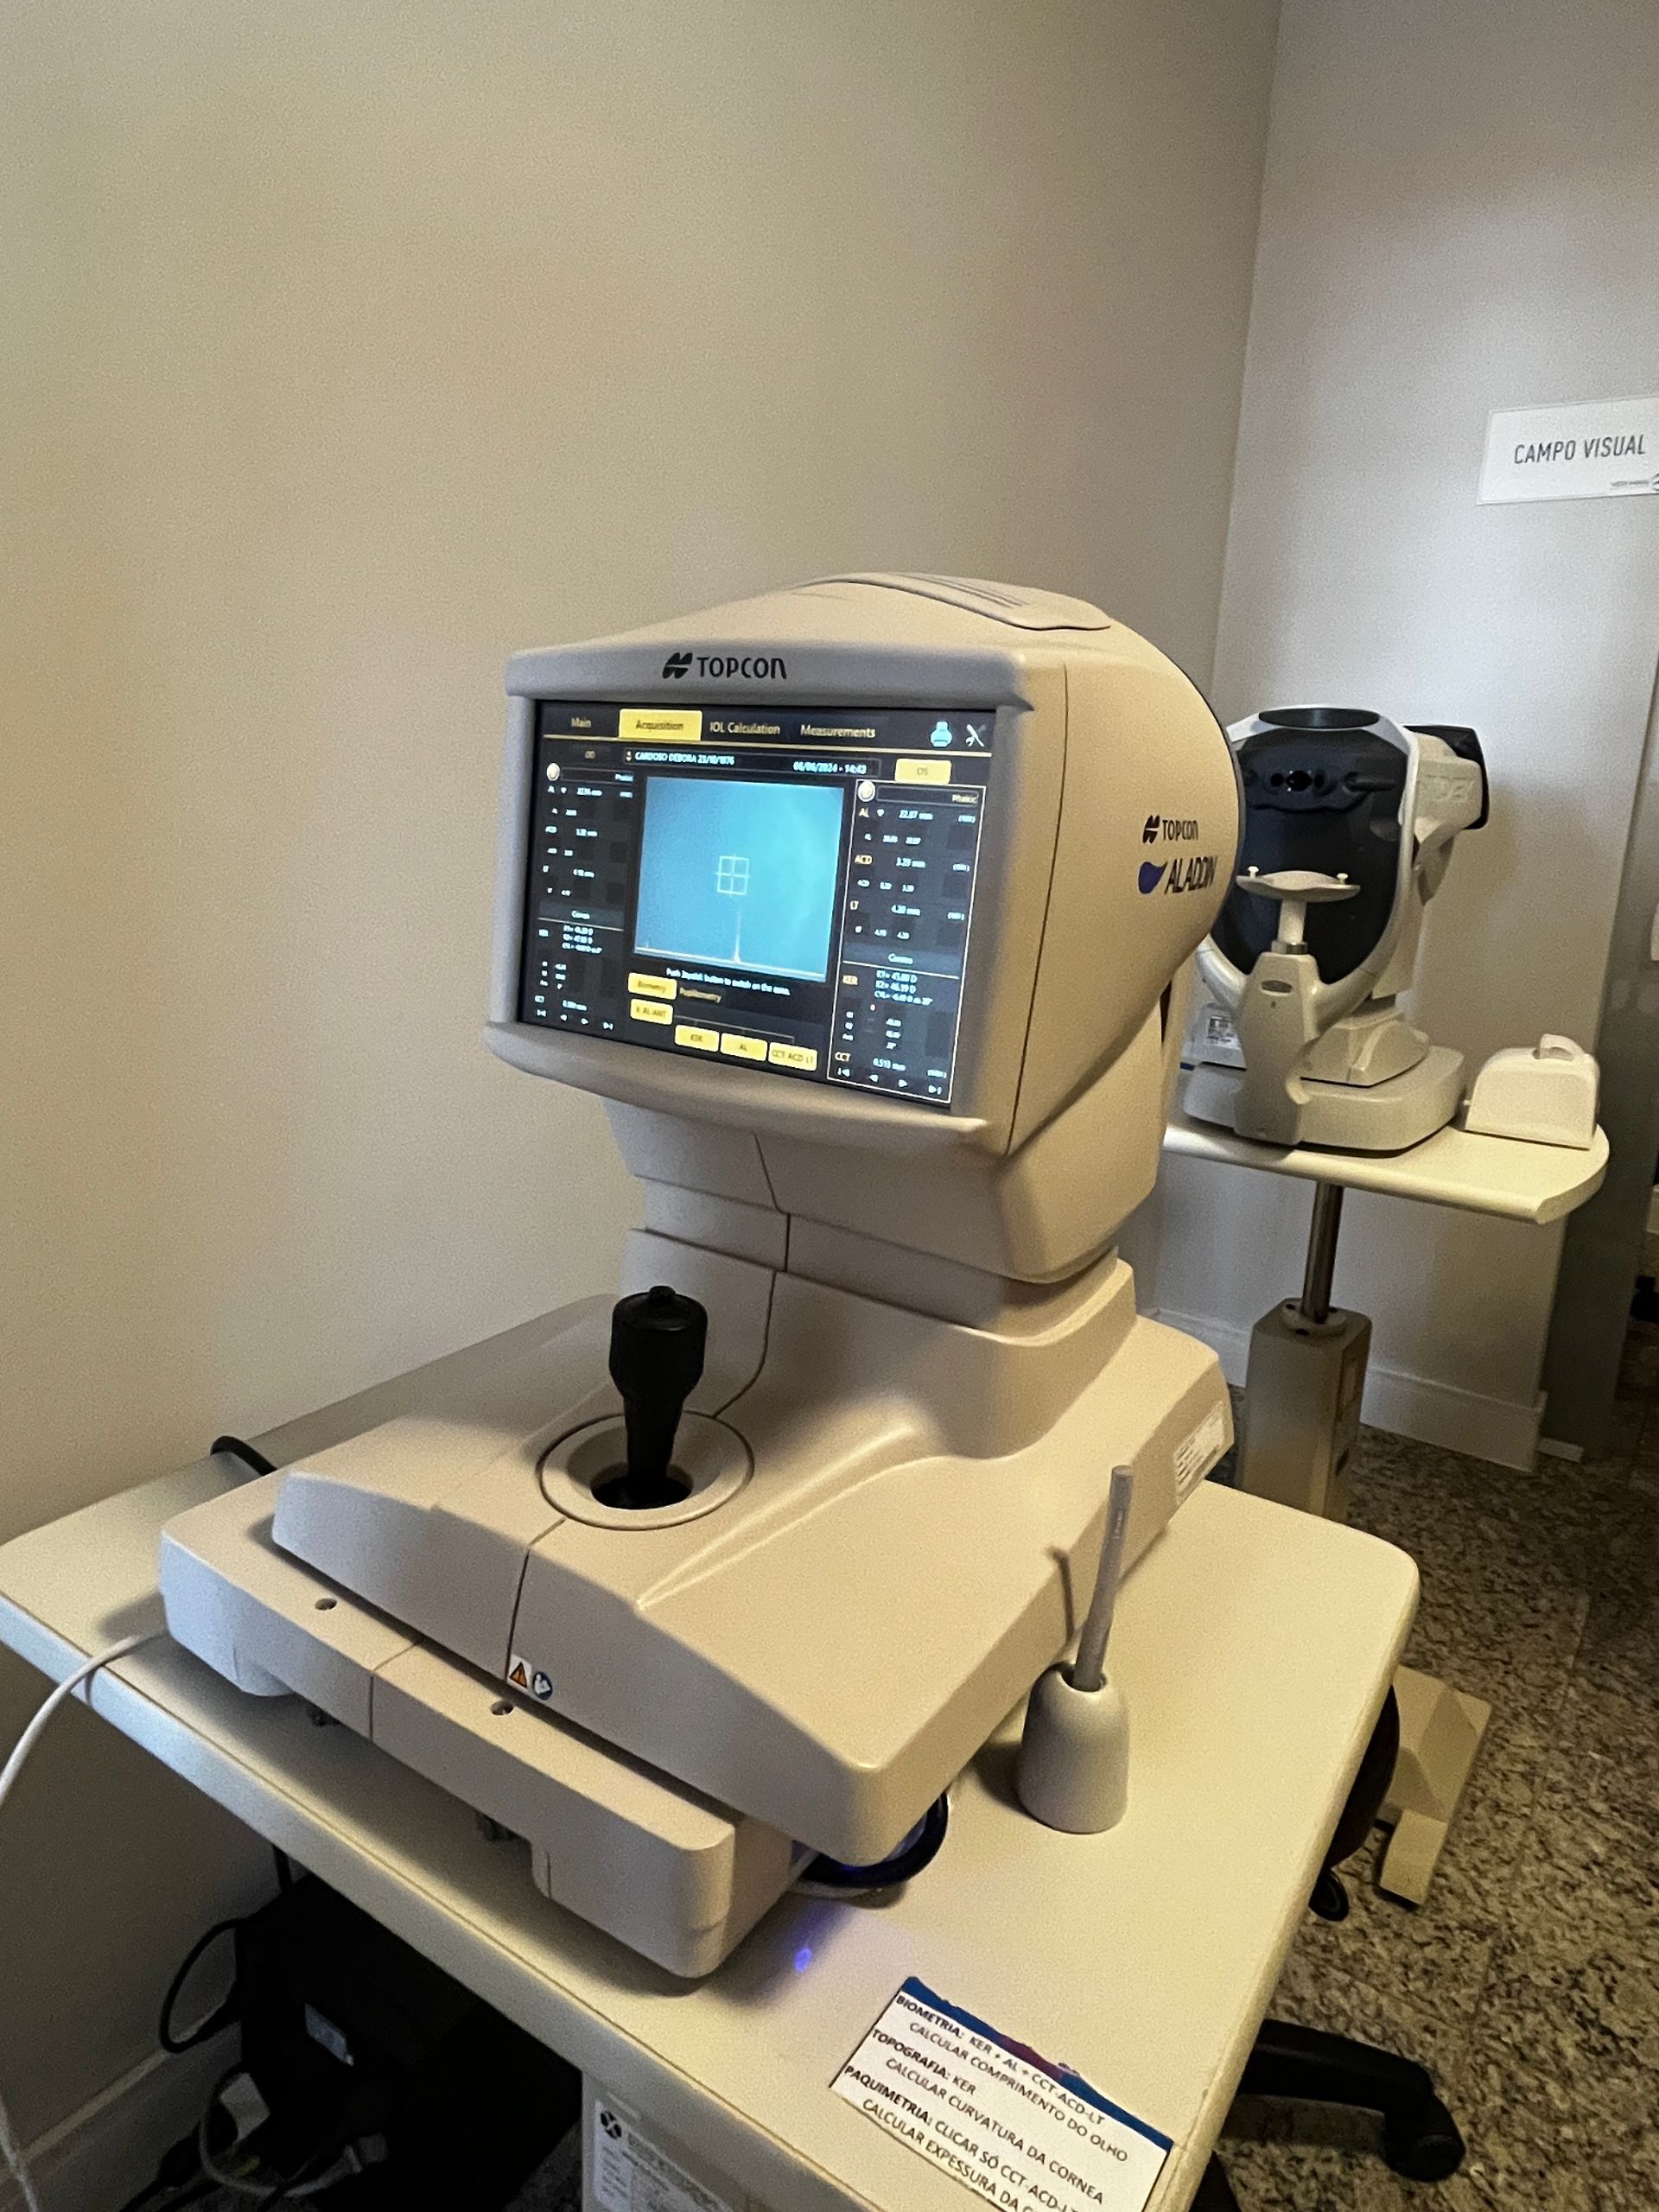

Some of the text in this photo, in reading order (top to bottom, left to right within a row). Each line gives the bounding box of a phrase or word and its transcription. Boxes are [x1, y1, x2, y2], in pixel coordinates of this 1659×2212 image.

[1514, 434, 1646, 464] CAMPO VISUAL
[696, 657, 787, 680] TOPCON
[570, 717, 876, 739] Main Acquisition IOL Calculation Measurements
[858, 807, 870, 818] AL
[1162, 820, 1199, 842] TOPCON
[872, 2028, 977, 2095] TOPOGRAFIA: KER
[896, 1994, 965, 2039] BIOMETRIA:
[969, 2036, 993, 2055] KER
[1003, 2058, 1018, 2071] AL
[1031, 2073, 1106, 2125] CCT-ACD-LT
[910, 2022, 1128, 2162] CALCULAR COMPRIMENTO DO OLHO
[844, 2065, 1079, 2212] PAQUIMETRIA: CLICAR SÓ CCT-ACD-L
[862, 2098, 1020, 2212] CALCULAR EXPESSURA DA
[886, 2057, 1103, 2204] CALCULAR CURVATURA DA CORNEA
